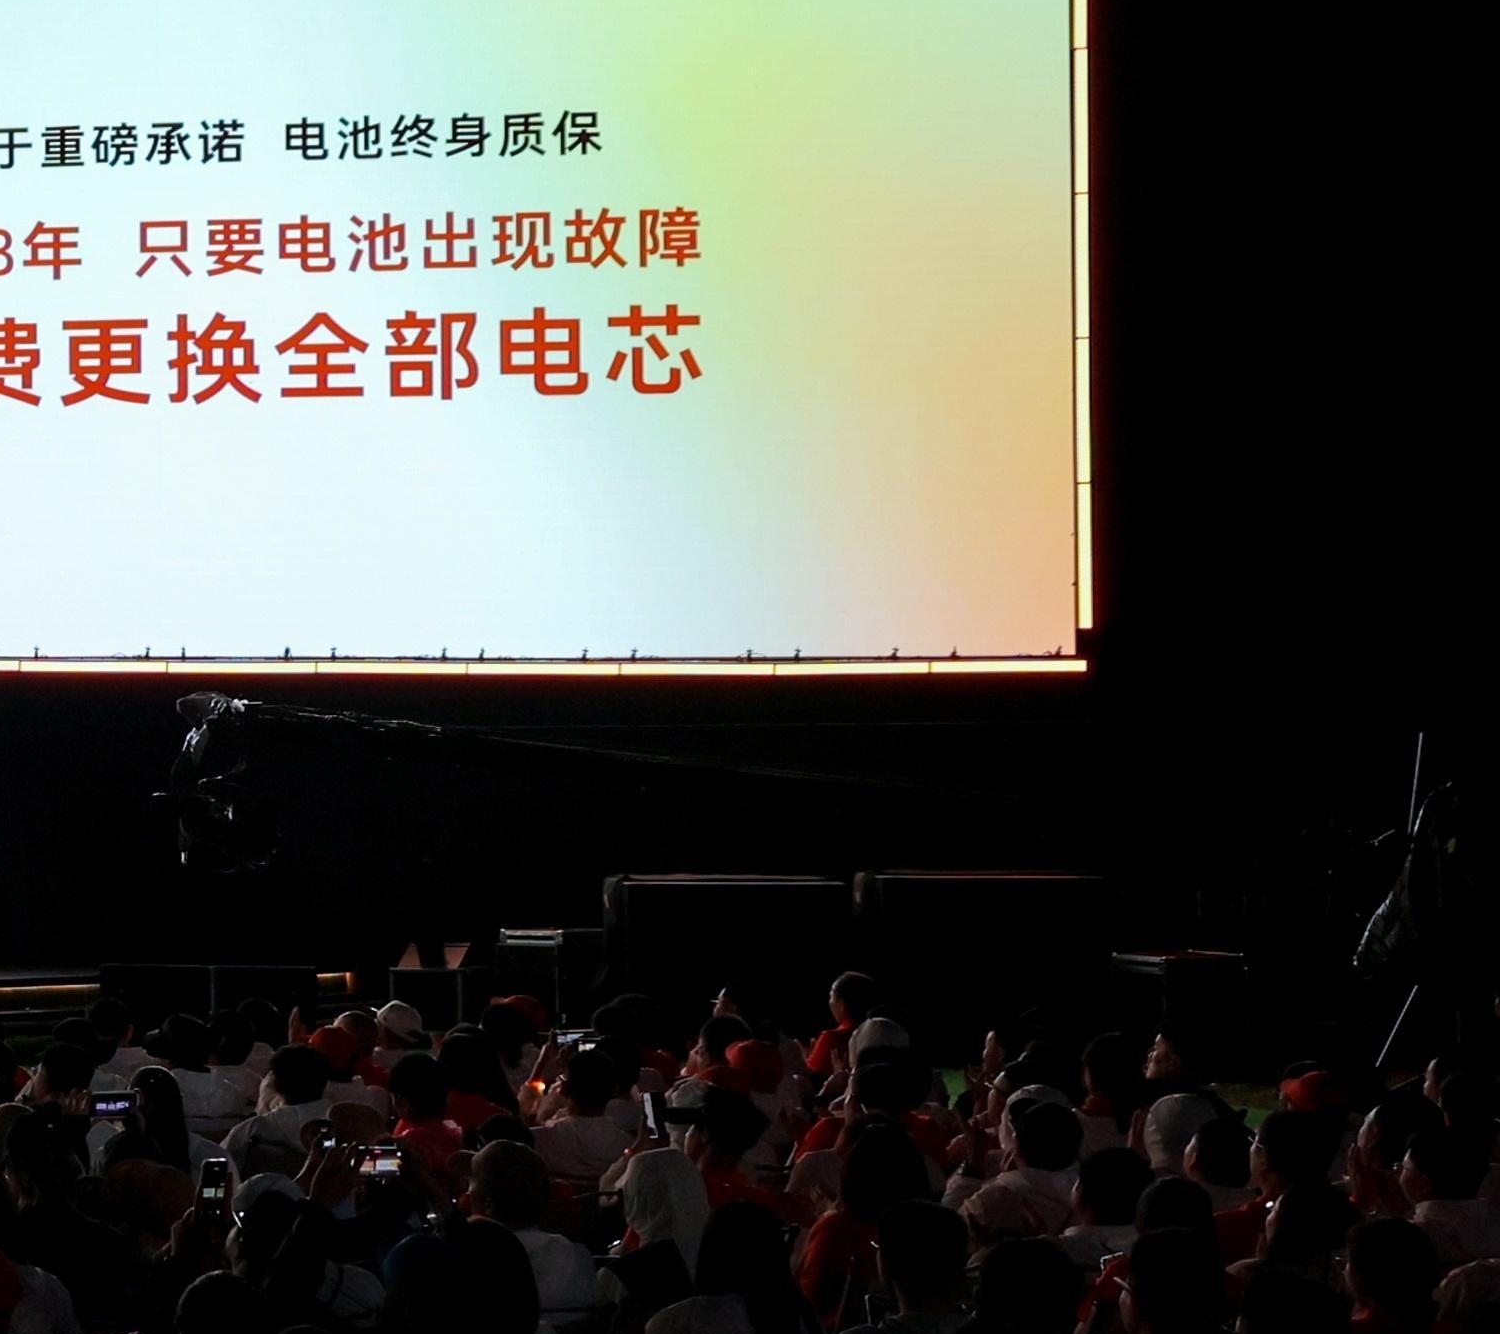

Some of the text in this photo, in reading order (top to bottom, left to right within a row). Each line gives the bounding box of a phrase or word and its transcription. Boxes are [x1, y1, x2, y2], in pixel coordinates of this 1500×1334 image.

[285, 109, 603, 161] 电池终身质保
[136, 206, 702, 278] 只要电池出现故障
